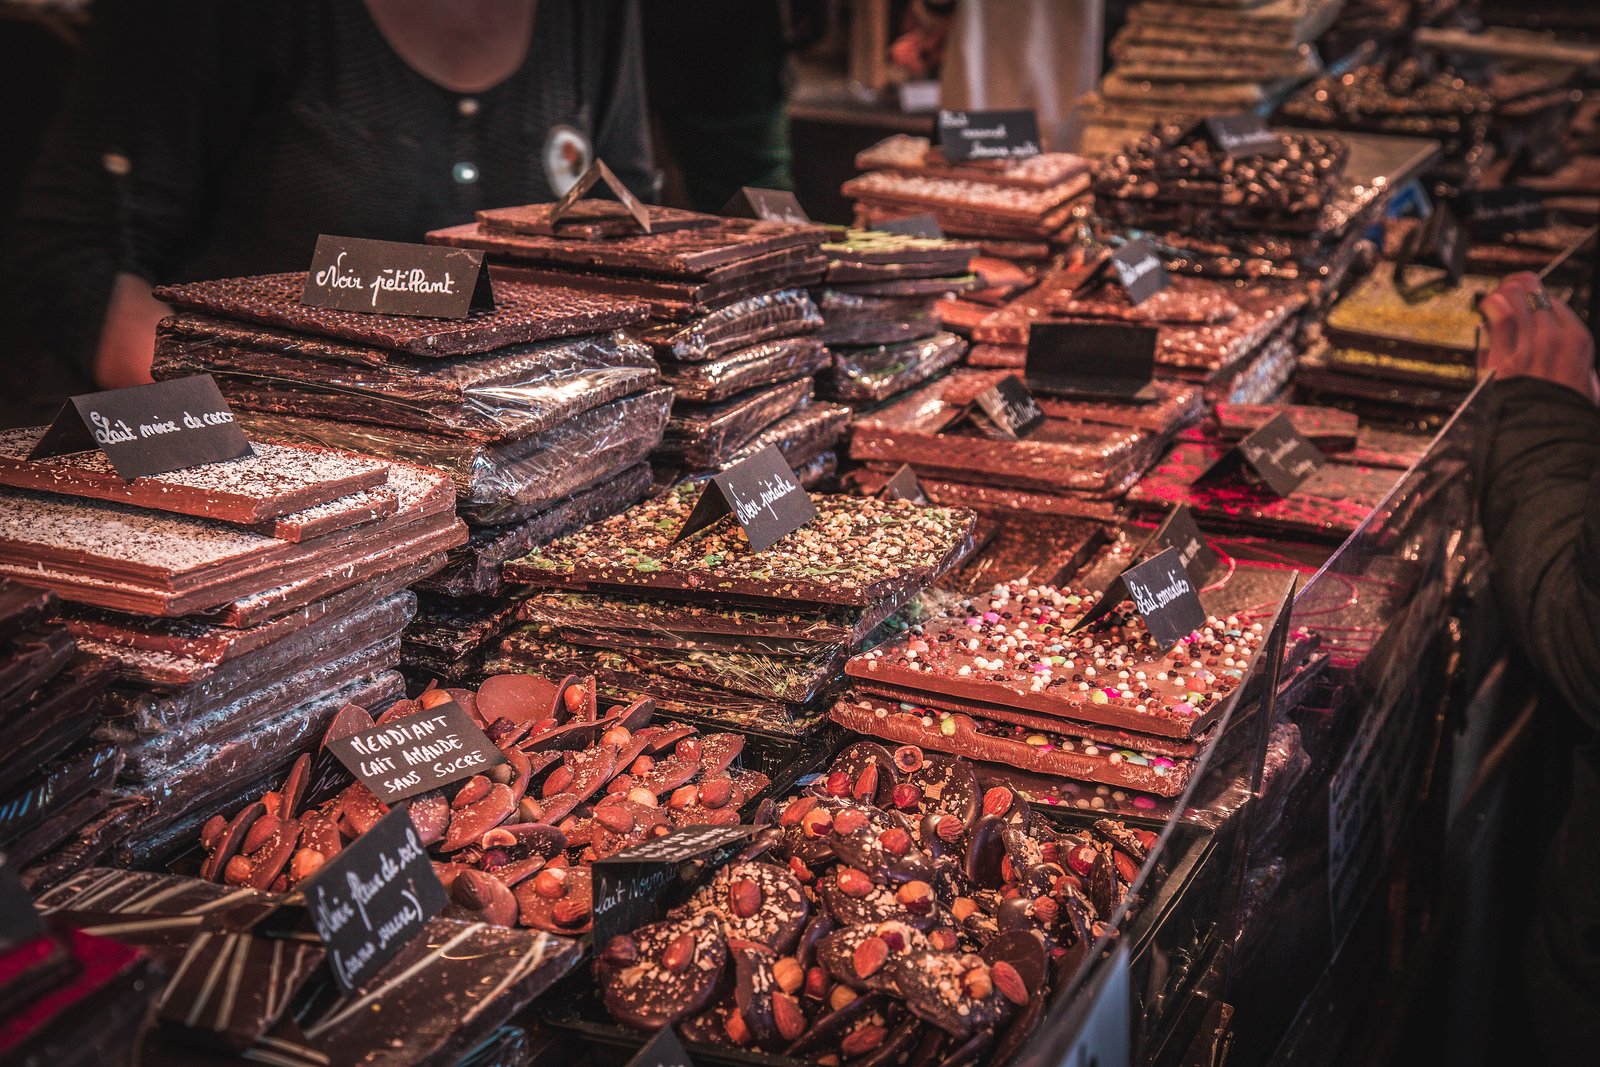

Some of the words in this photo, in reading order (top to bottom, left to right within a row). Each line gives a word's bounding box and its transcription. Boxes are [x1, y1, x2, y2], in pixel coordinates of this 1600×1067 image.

[316, 252, 363, 289] Noir
[90, 411, 137, 444] Lait
[183, 411, 206, 429] de
[203, 411, 234, 427] coco
[729, 482, 762, 525] Noir
[759, 473, 796, 521] pistache
[1129, 580, 1159, 616] Lait
[1156, 569, 1190, 609] smarties
[350, 715, 449, 755] MENDIANT
[360, 756, 397, 777] LAIT
[401, 734, 463, 766] AMANDE
[383, 771, 421, 794] SANS
[433, 750, 486, 778] SUCRE
[316, 885, 354, 942] Noir
[346, 871, 385, 932] fleur
[379, 852, 399, 882] de
[398, 827, 423, 870] sel
